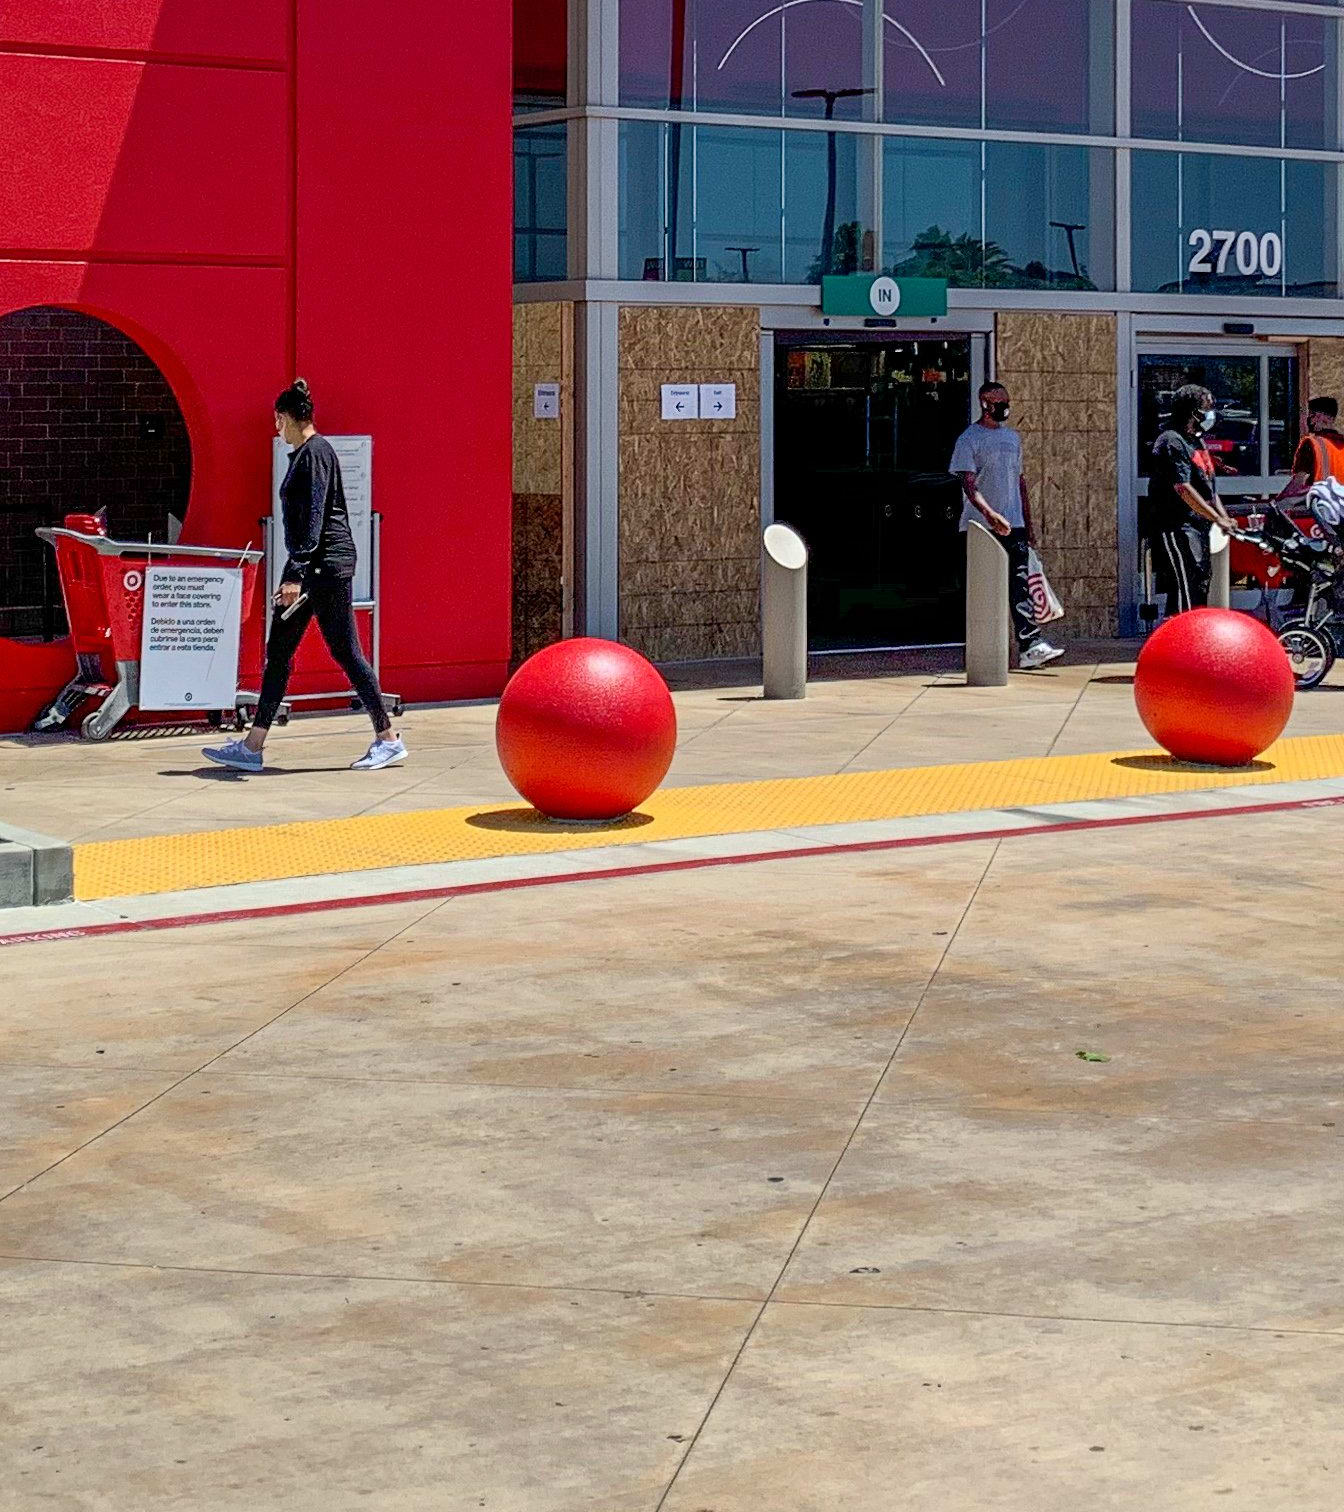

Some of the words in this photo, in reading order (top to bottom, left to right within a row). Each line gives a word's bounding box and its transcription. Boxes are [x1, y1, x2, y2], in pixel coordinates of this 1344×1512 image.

[1188, 229, 1282, 277] 2700
[878, 289, 892, 302] IN
[153, 574, 167, 582] Due
[187, 575, 224, 584] emergency
[192, 593, 221, 601] covering
[151, 617, 176, 625] Debido
